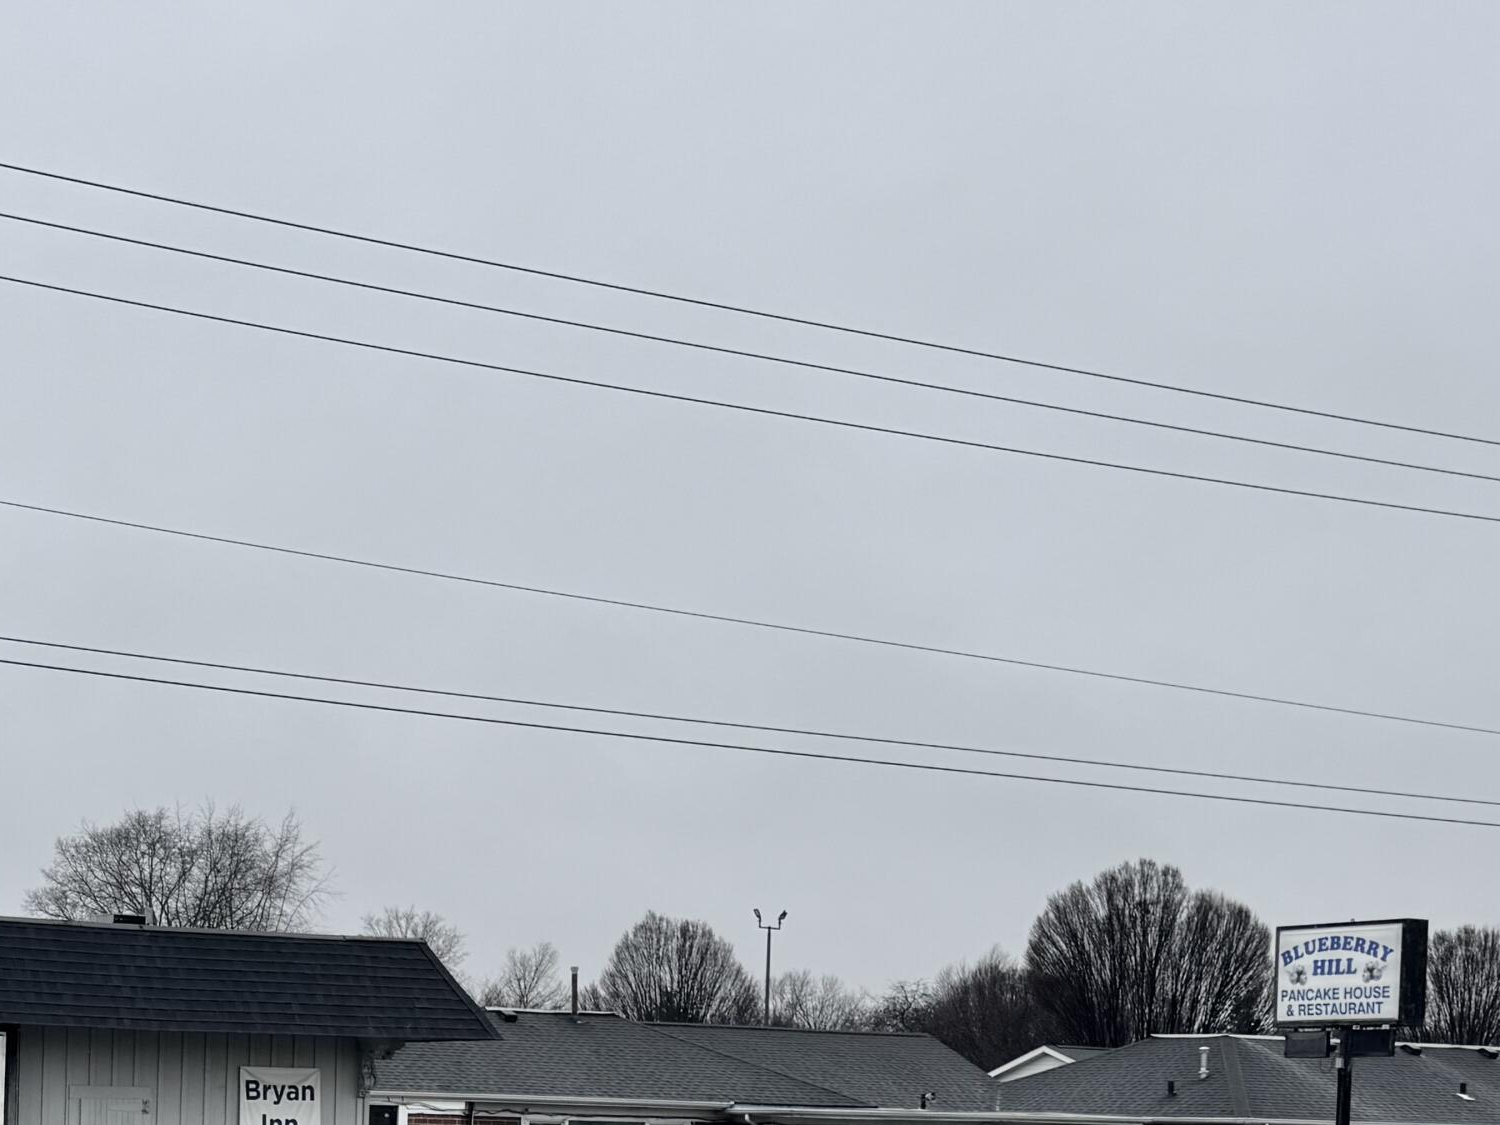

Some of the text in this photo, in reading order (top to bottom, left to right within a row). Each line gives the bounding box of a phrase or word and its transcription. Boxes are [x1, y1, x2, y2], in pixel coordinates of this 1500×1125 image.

[1281, 935, 1394, 967] BLUEBERRY
[1312, 958, 1357, 976] HILL
[1281, 986, 1390, 1002] PANCAKE HOUSE
[1286, 1001, 1384, 1017] & RESTAURANT
[245, 1080, 315, 1105] Bryan
